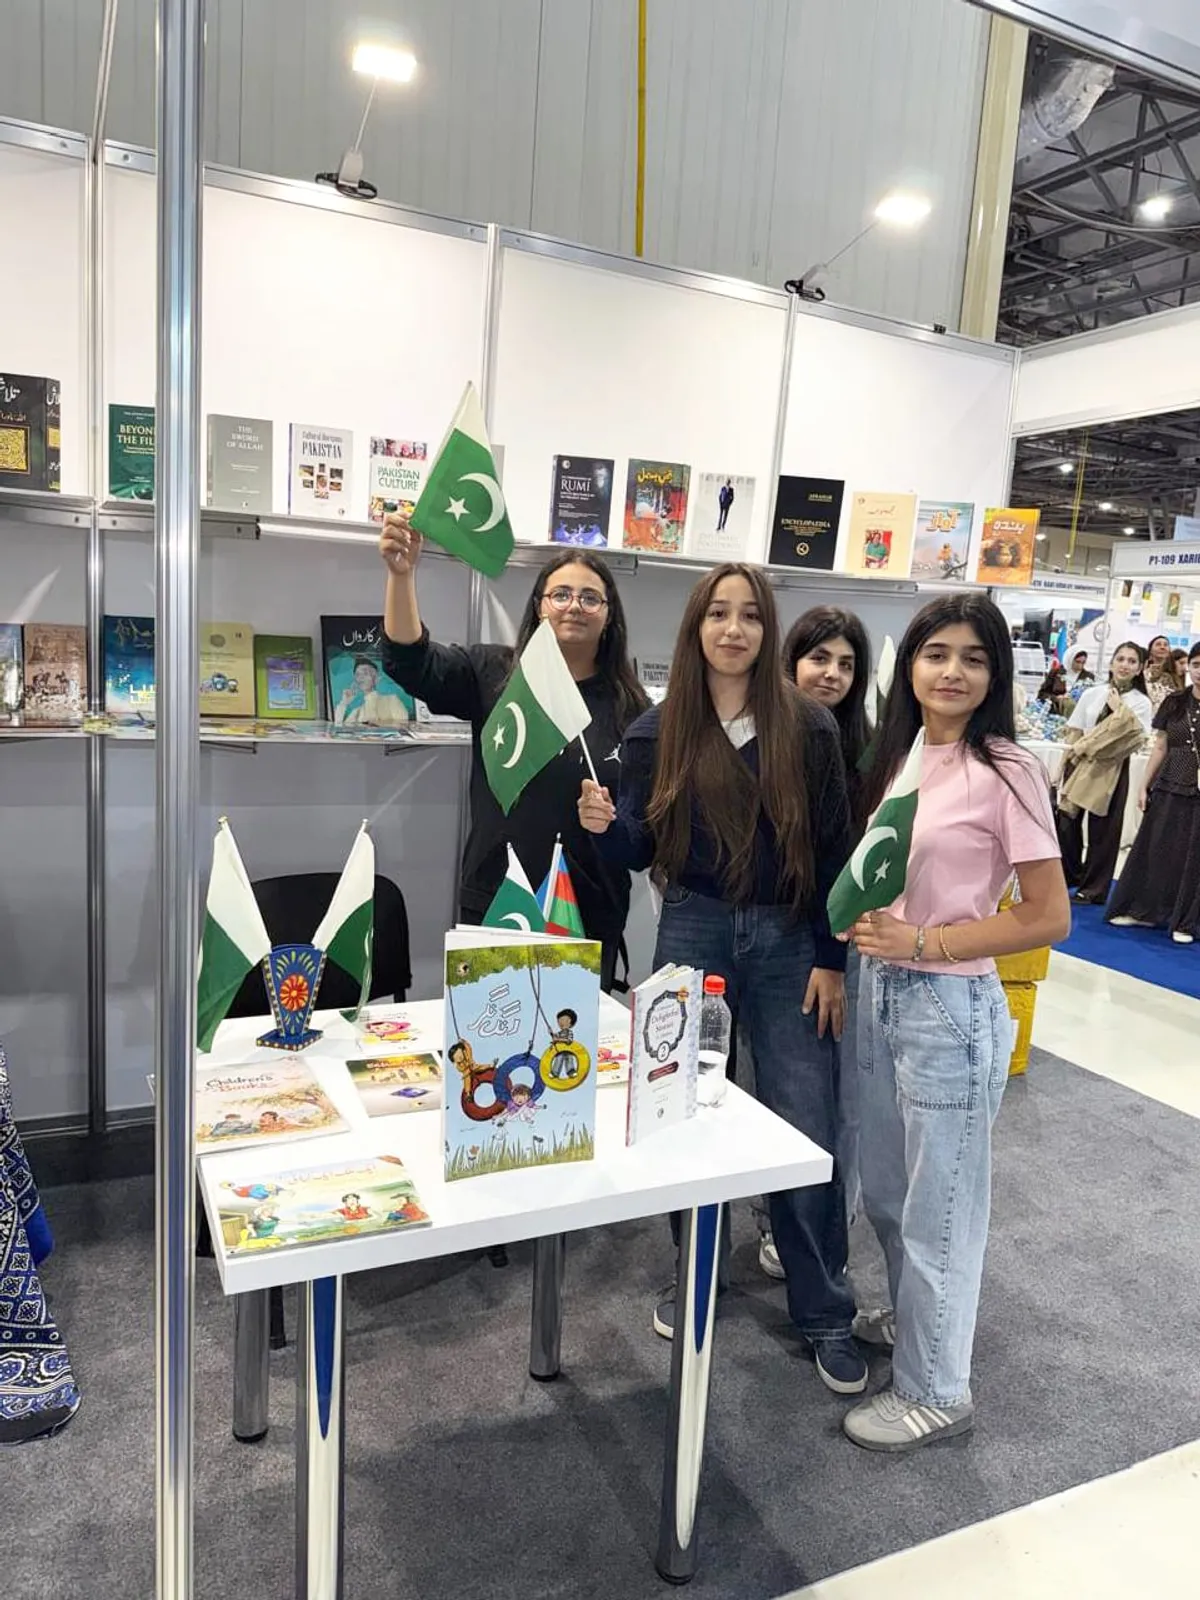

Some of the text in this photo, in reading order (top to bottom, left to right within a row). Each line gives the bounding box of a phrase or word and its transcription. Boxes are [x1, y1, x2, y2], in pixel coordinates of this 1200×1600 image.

[120, 424, 156, 435] BEYON
[116, 434, 155, 446] THE FIL
[238, 442, 264, 452] ALLAH
[302, 440, 342, 459] PAKISTAN
[377, 465, 420, 481] PAKISTAN
[378, 477, 419, 491] CULTURE
[561, 479, 590, 492] RUMI
[1148, 554, 1176, 566] P1-109
